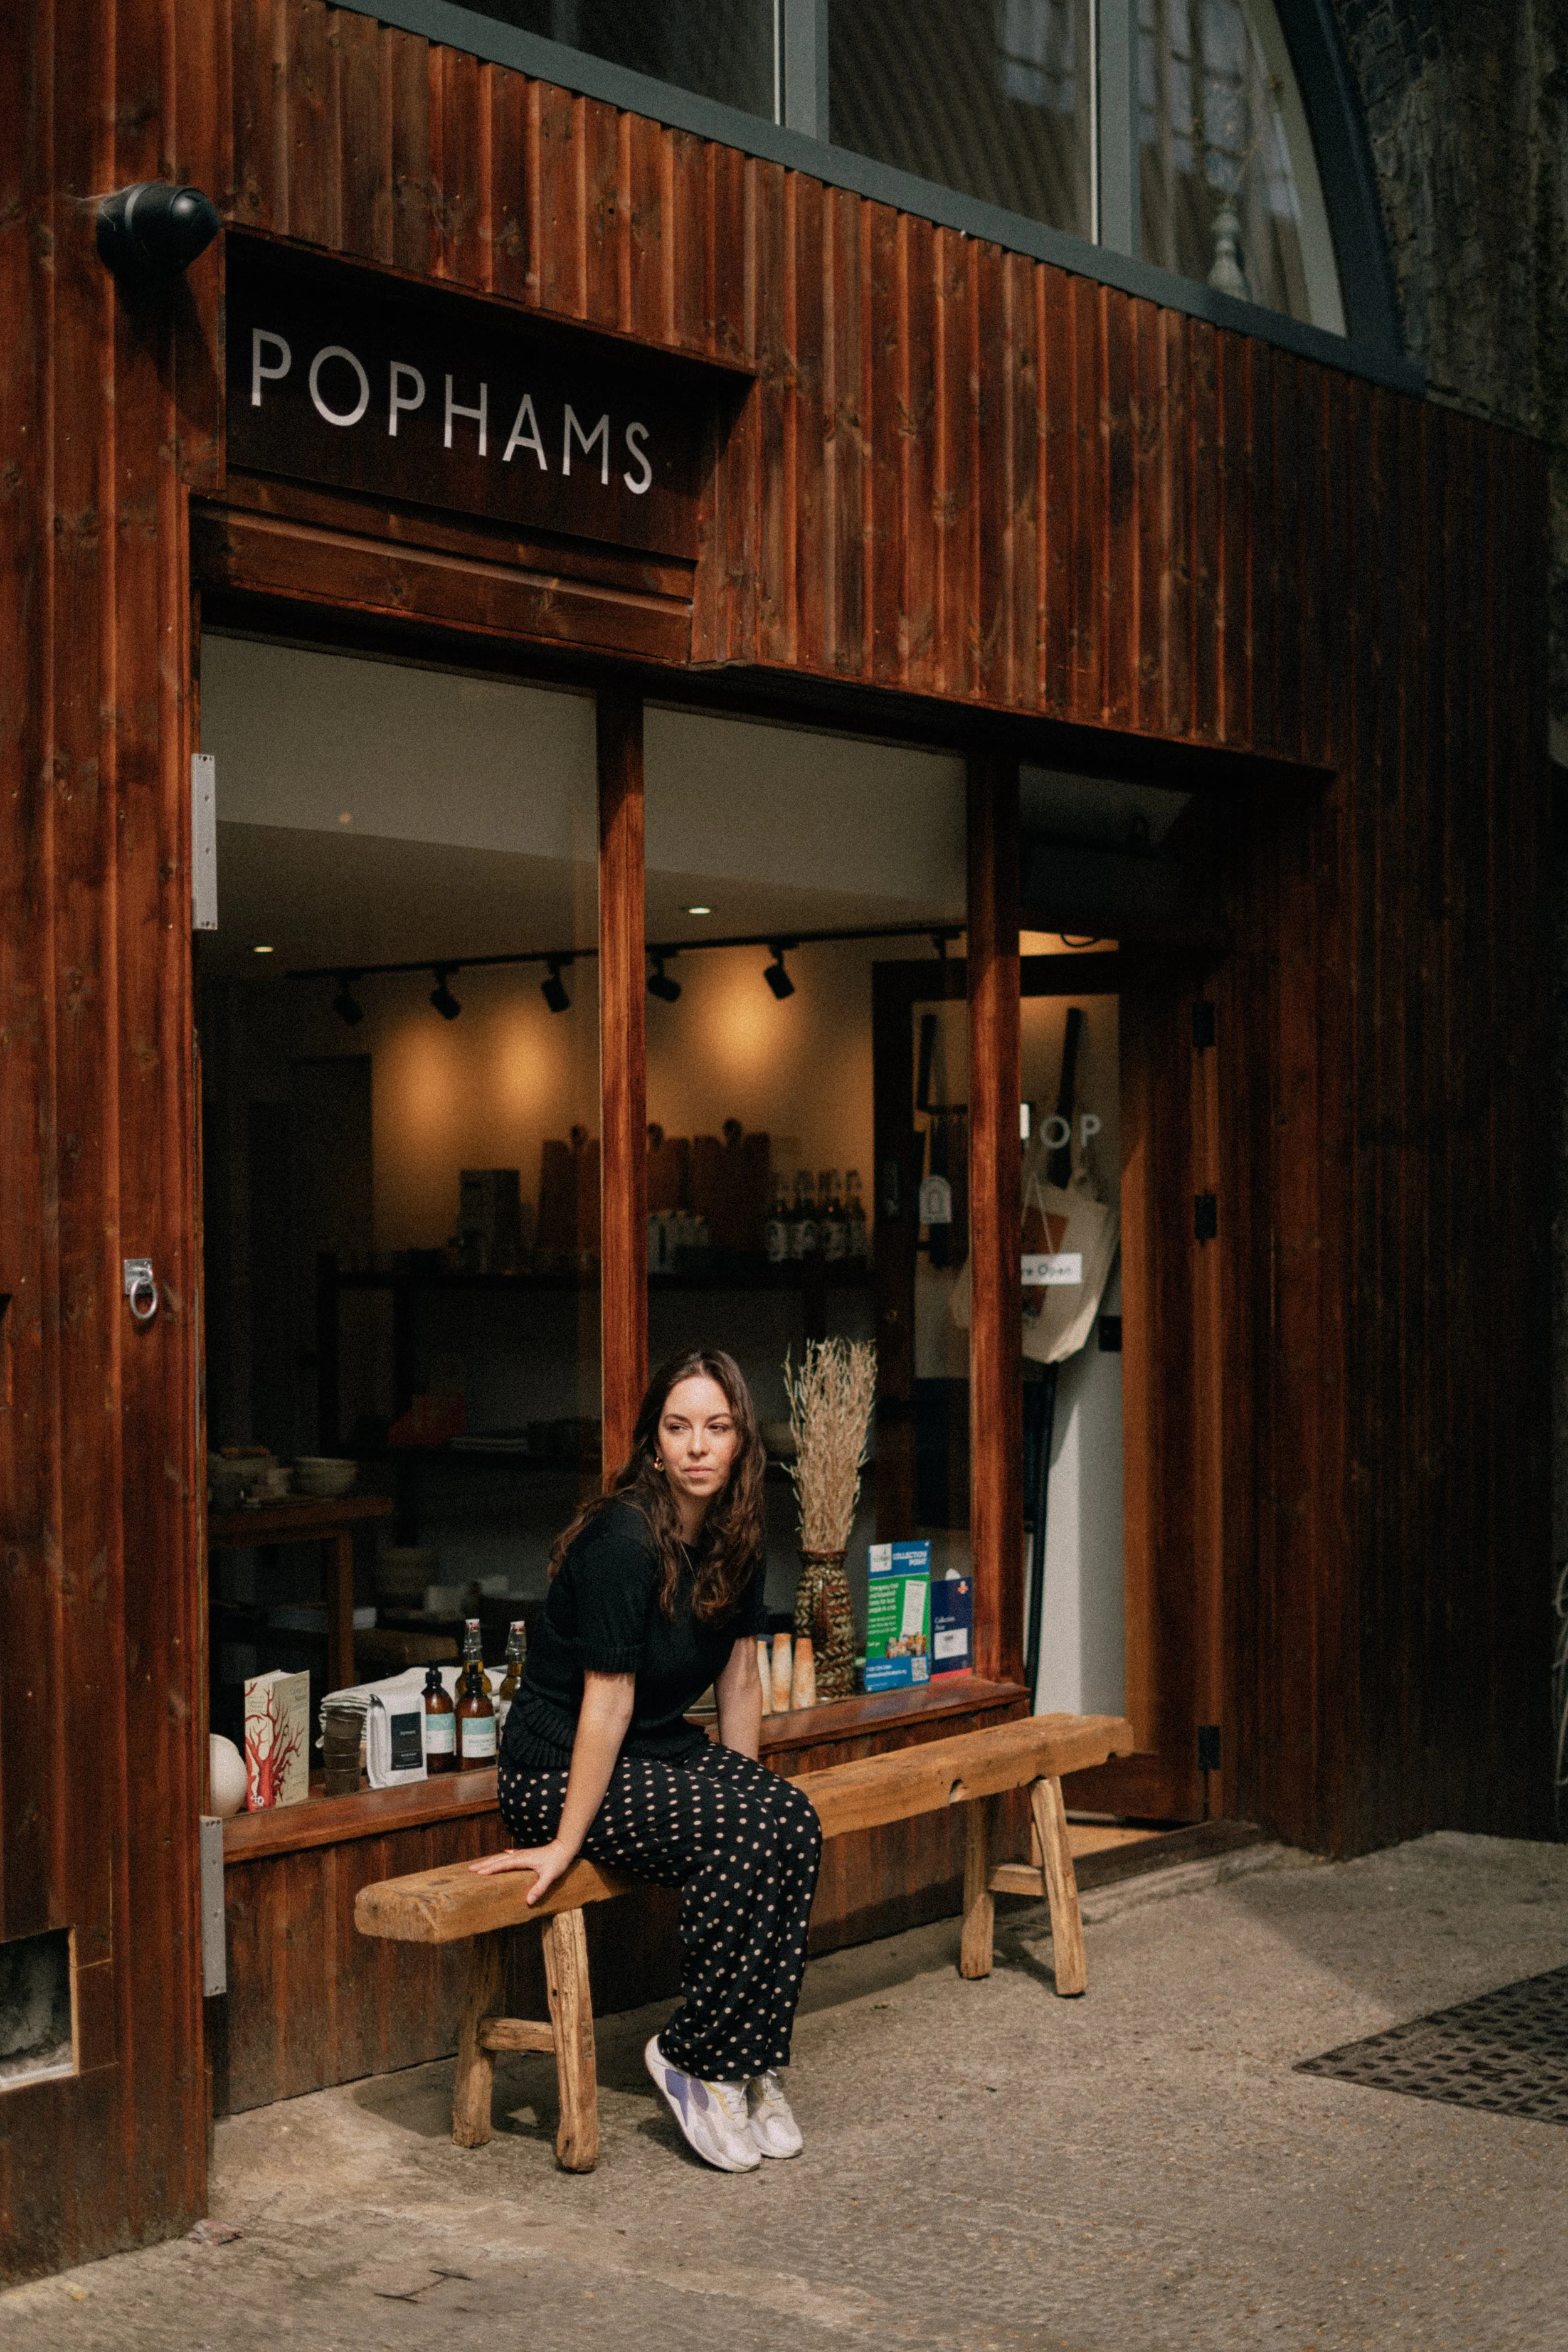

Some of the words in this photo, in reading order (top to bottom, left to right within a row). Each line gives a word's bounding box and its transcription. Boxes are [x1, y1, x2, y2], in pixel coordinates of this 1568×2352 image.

[252, 327, 652, 494] POPHAMS
[1024, 1112, 1101, 1149] OP
[893, 1550, 927, 1560] COLLECTION
[908, 1557, 927, 1567] POINT
